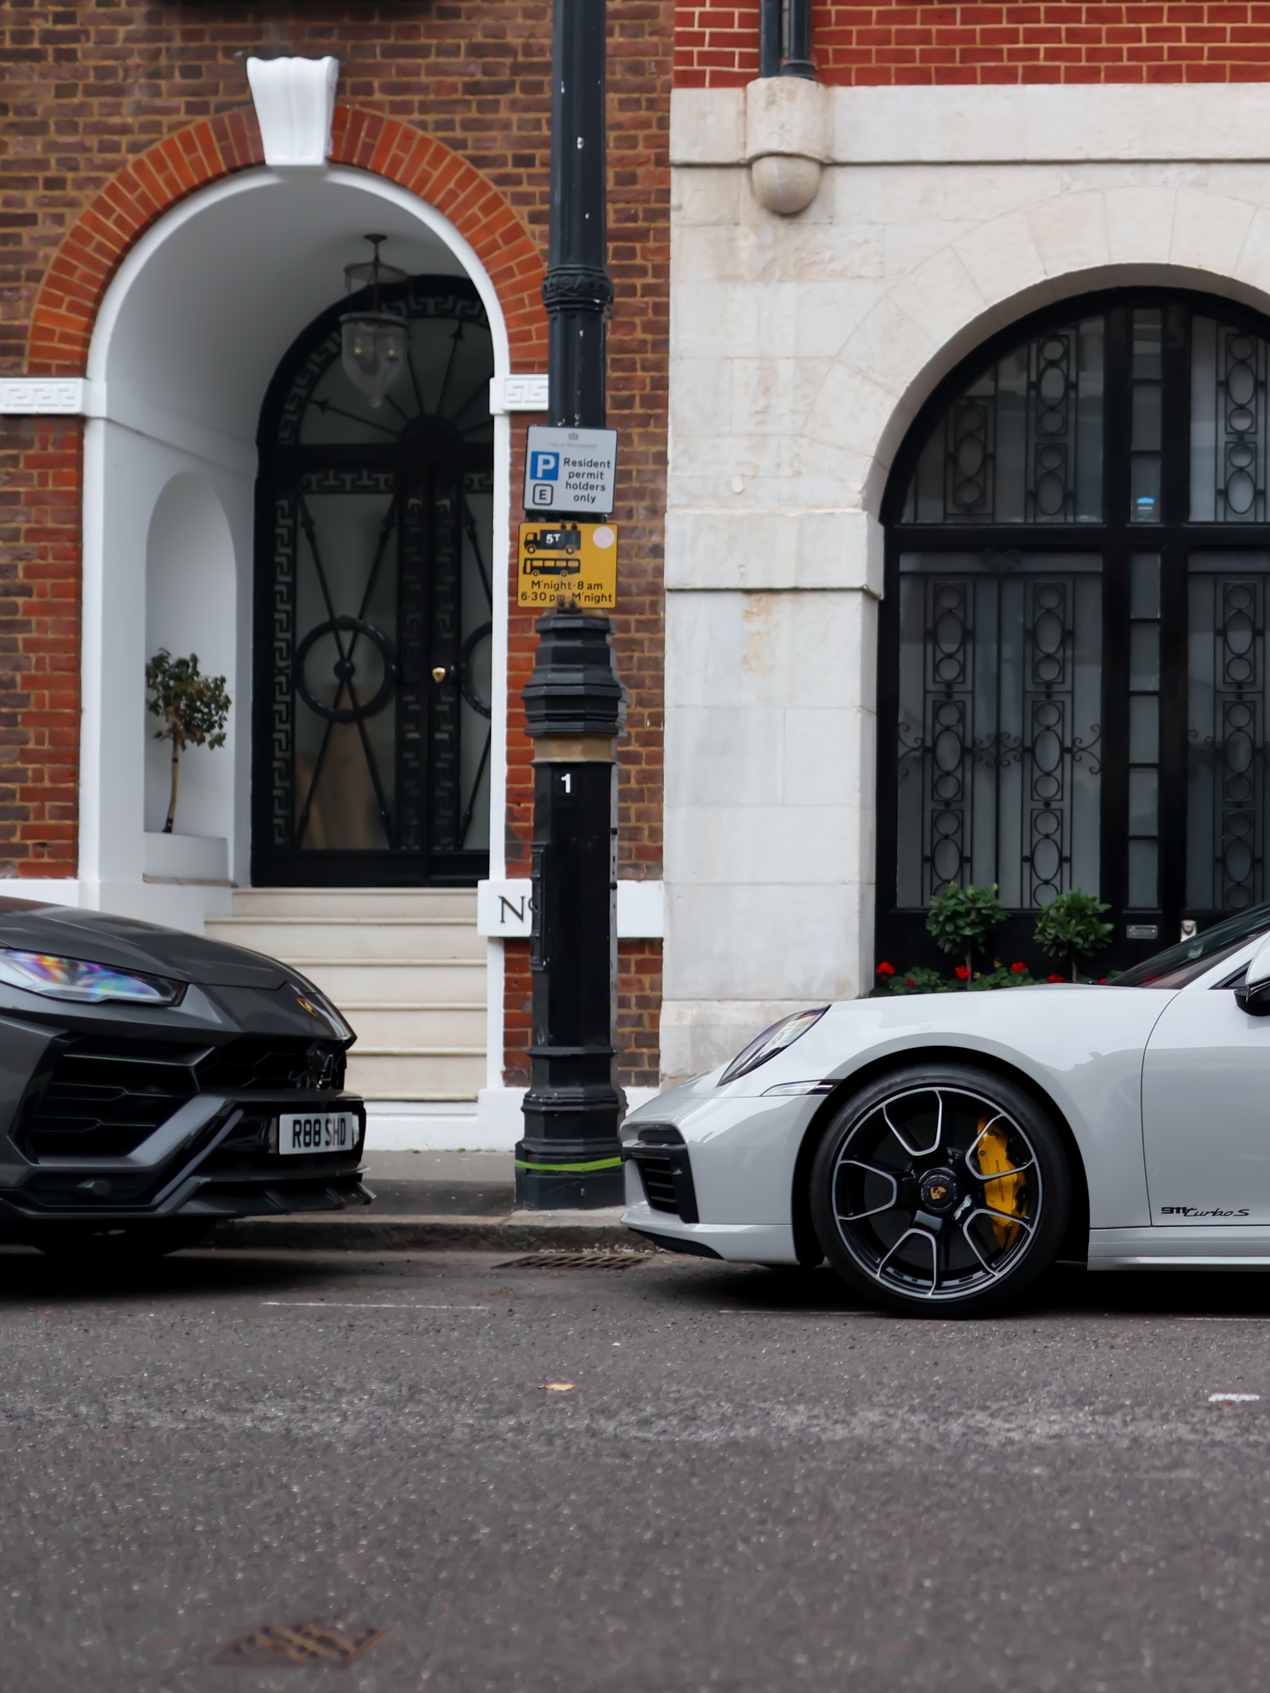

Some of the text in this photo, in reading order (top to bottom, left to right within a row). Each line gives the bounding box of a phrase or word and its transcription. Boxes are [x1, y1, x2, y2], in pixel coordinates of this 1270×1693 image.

[537, 454, 555, 478] P
[563, 457, 611, 469] Resident
[568, 471, 604, 480] permit
[565, 481, 606, 491] holders
[539, 489, 547, 500] E
[573, 493, 596, 504] only
[546, 533, 561, 544] 5T
[561, 773, 571, 793] 1
[292, 1117, 346, 1148] R88 SHD
[1233, 1208, 1250, 1216] S
